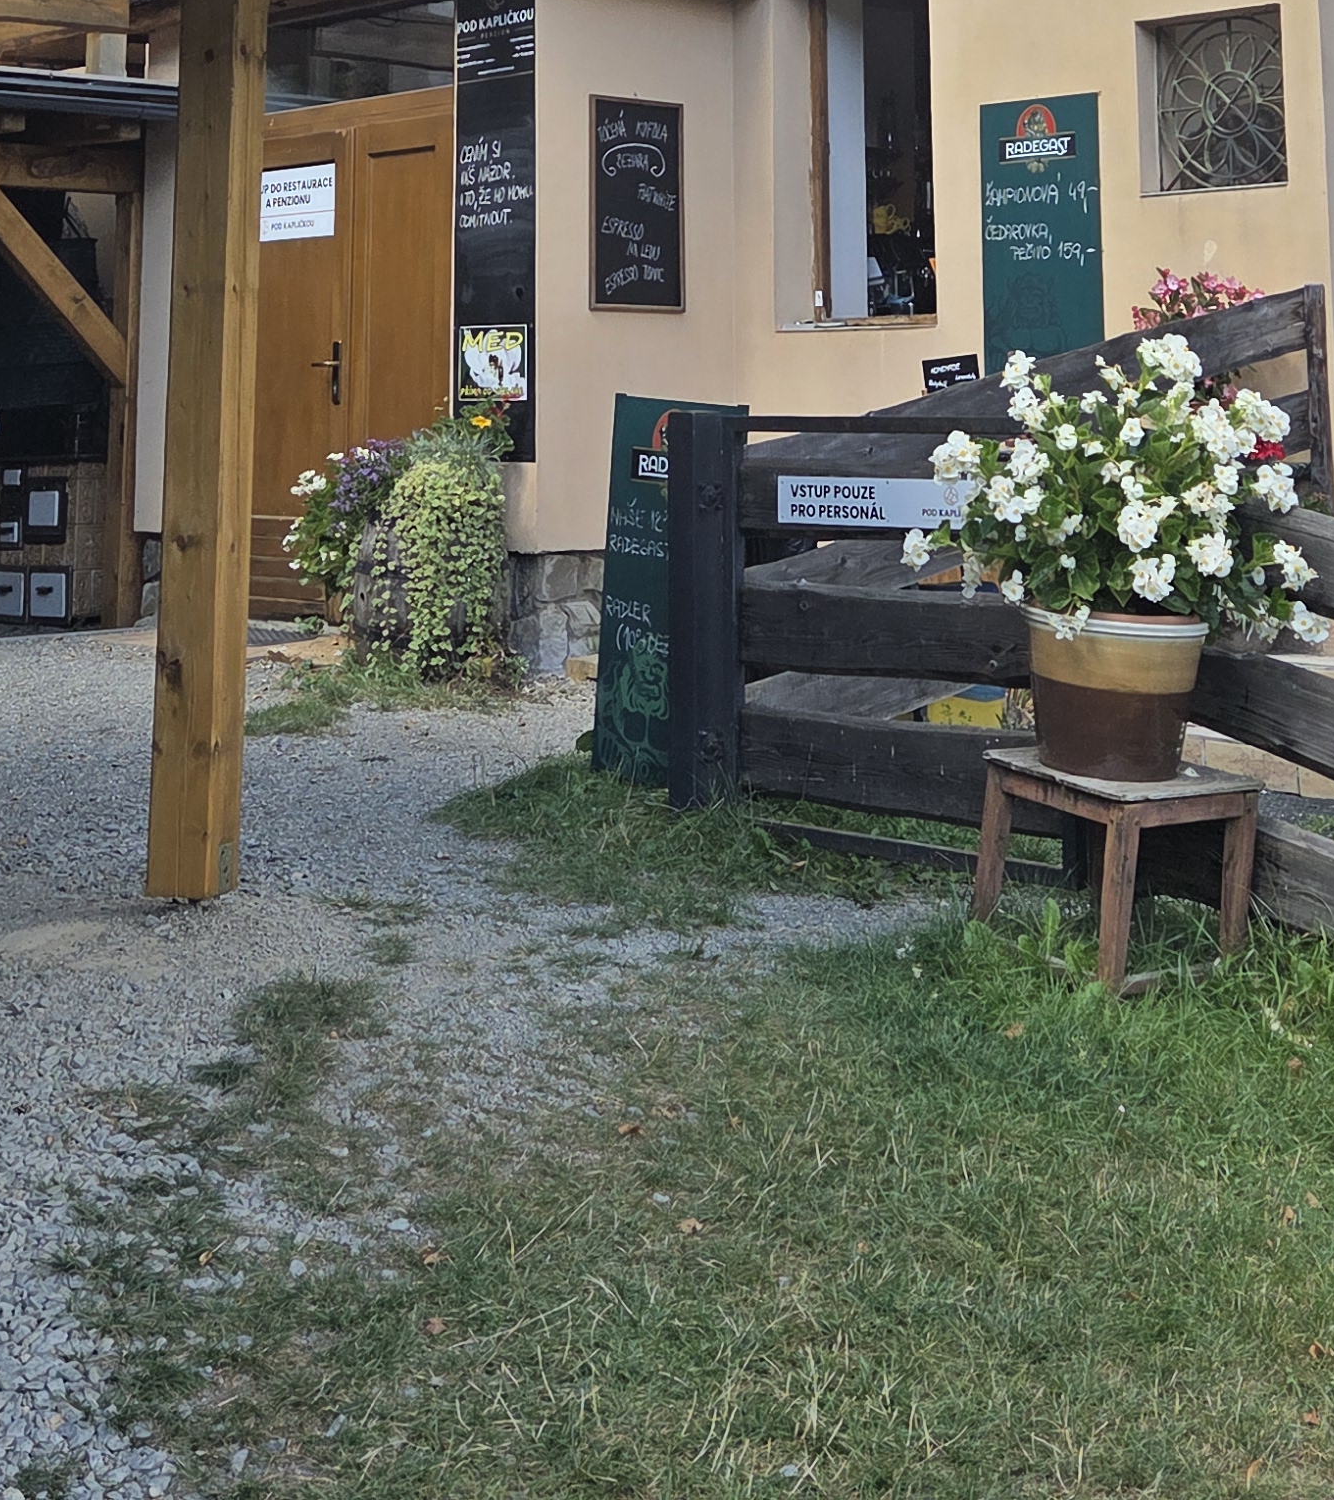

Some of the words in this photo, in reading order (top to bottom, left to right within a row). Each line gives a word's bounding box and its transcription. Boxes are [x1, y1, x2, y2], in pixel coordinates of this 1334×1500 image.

[457, 19, 477, 35] POD
[478, 7, 534, 31] KAPLIČKOU
[1005, 137, 1071, 159] RADEGAST
[270, 183, 282, 194] DO
[283, 177, 332, 192] RESTAURACE
[265, 198, 271, 208] A
[272, 194, 311, 208] PENZIONU
[462, 329, 523, 353] MED
[790, 484, 831, 499] VSTUP
[833, 485, 876, 500] POUZE
[790, 503, 816, 518] PRO
[818, 502, 886, 520] PERSONÁL
[922, 509, 938, 517] POD
[605, 595, 652, 628] RADLER
